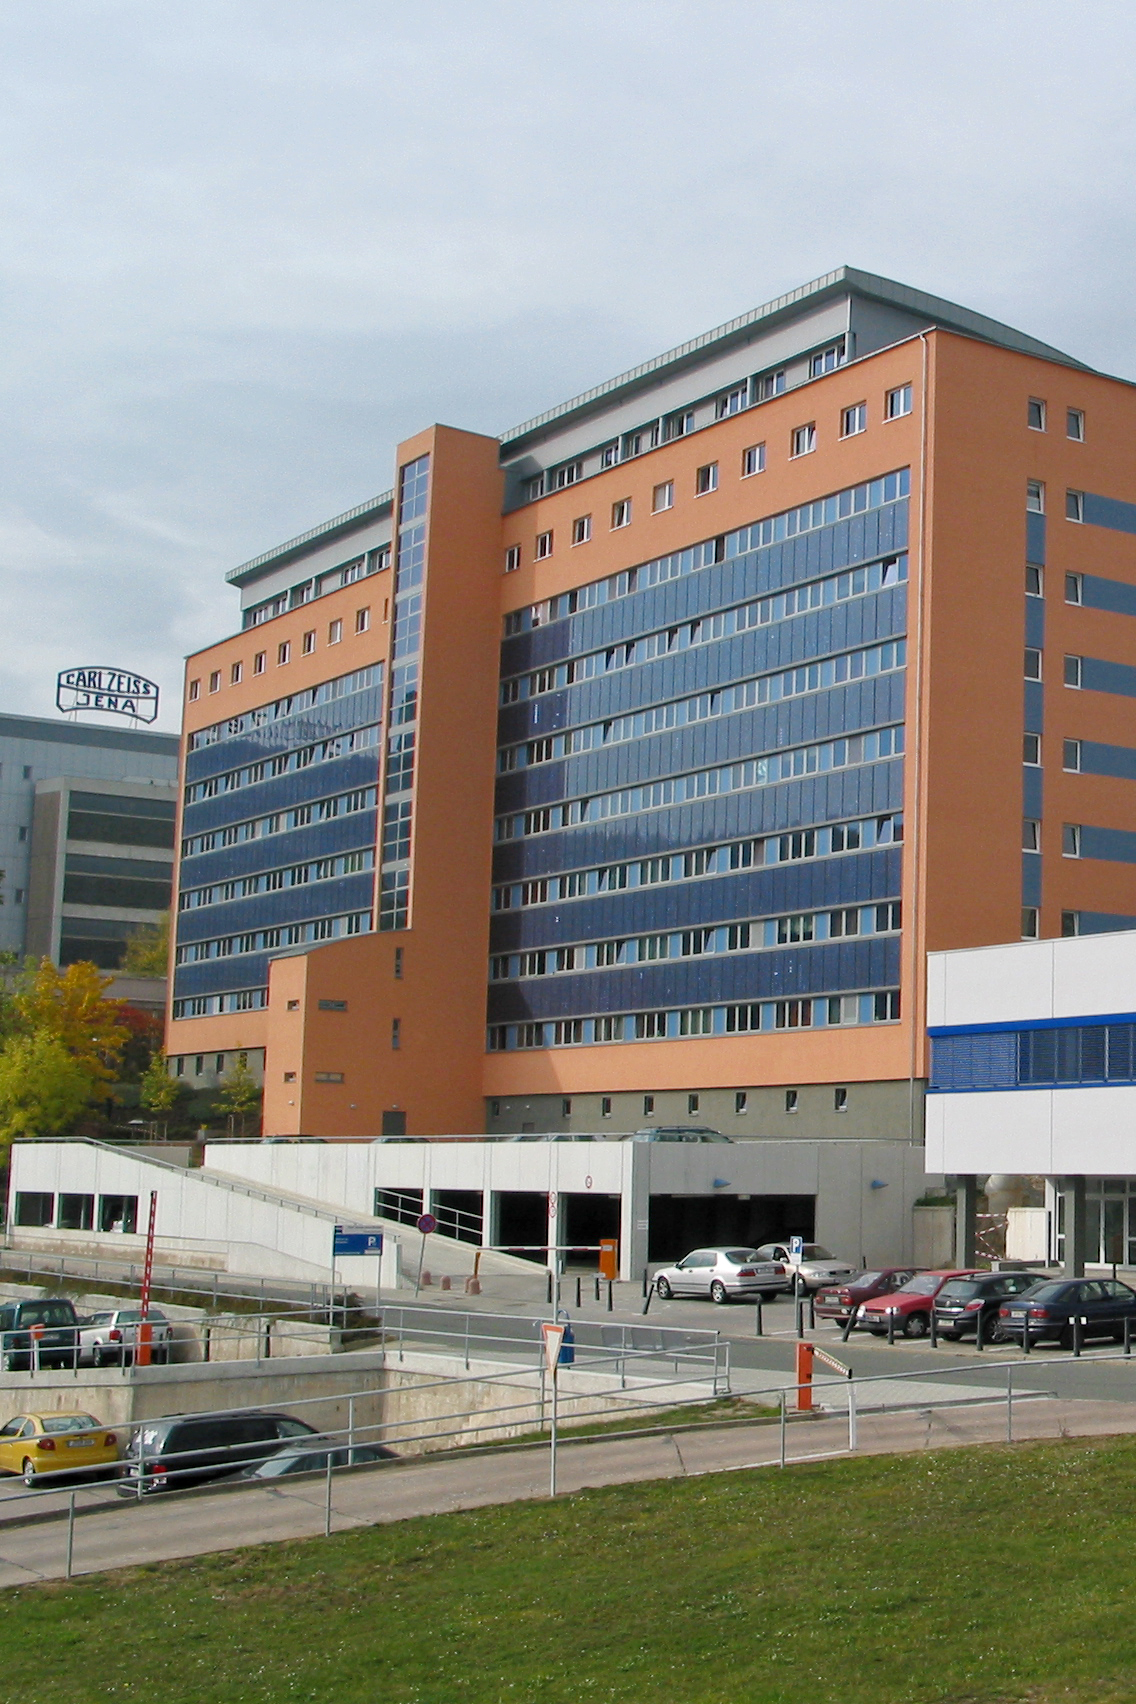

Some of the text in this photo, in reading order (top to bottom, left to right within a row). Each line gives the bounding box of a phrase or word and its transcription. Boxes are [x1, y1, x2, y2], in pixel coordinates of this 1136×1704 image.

[66, 671, 151, 694] CARL ZEISS
[76, 692, 136, 713] JENA
[368, 1236, 377, 1246] P
[792, 1238, 800, 1252] P
